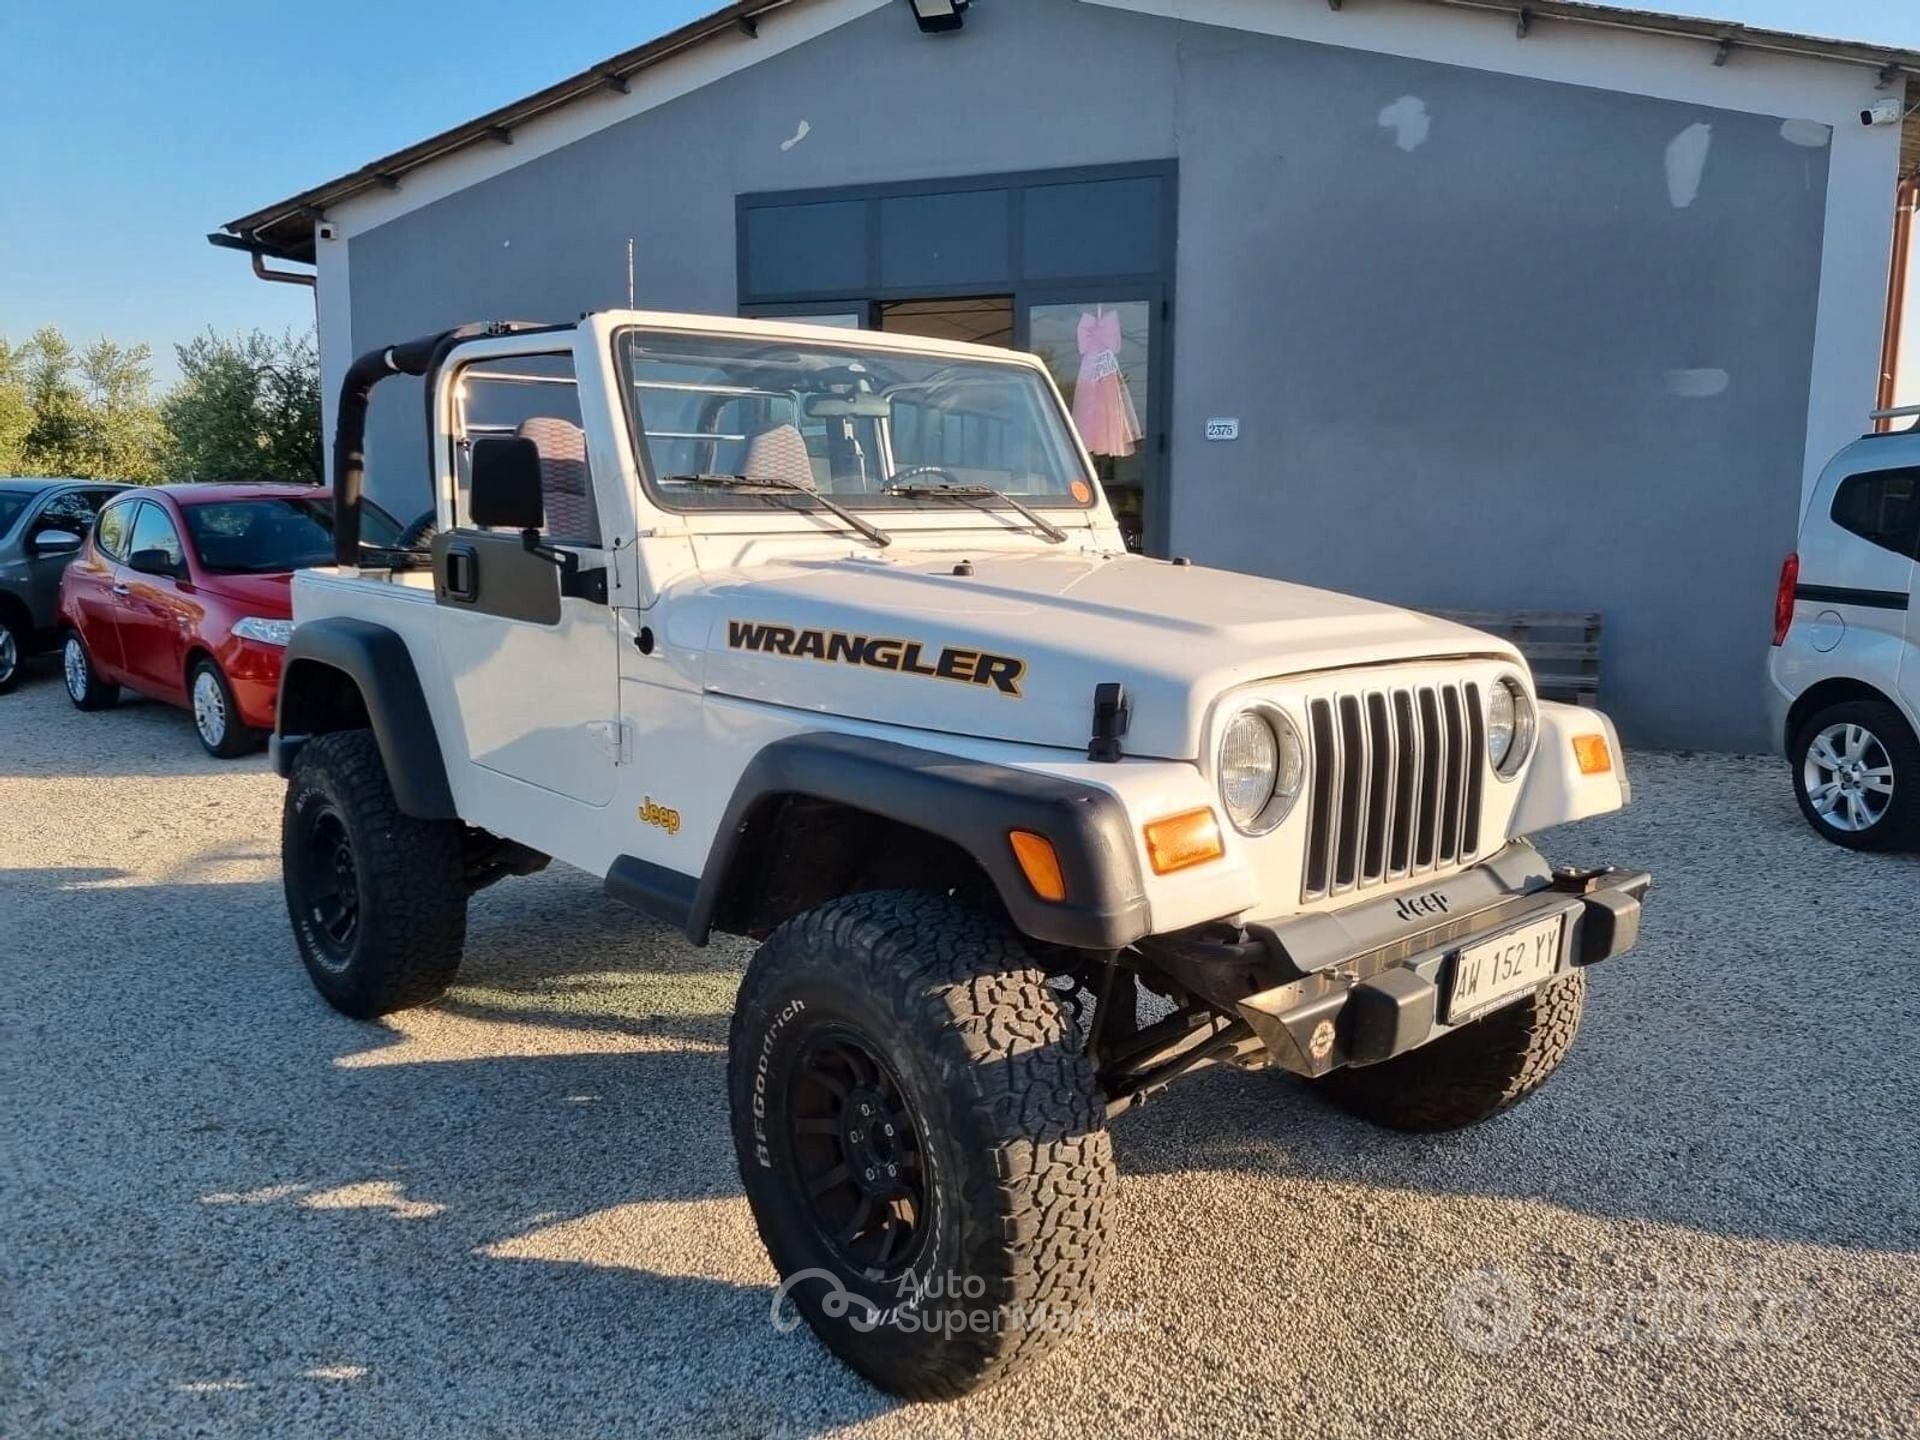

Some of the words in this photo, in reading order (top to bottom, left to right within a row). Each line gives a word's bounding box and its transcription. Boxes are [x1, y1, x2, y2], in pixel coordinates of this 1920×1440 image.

[728, 620, 1026, 698] WRANGLER
[638, 795, 681, 836] Jeep
[1491, 941, 1526, 986] 152
[1535, 928, 1558, 968] YY
